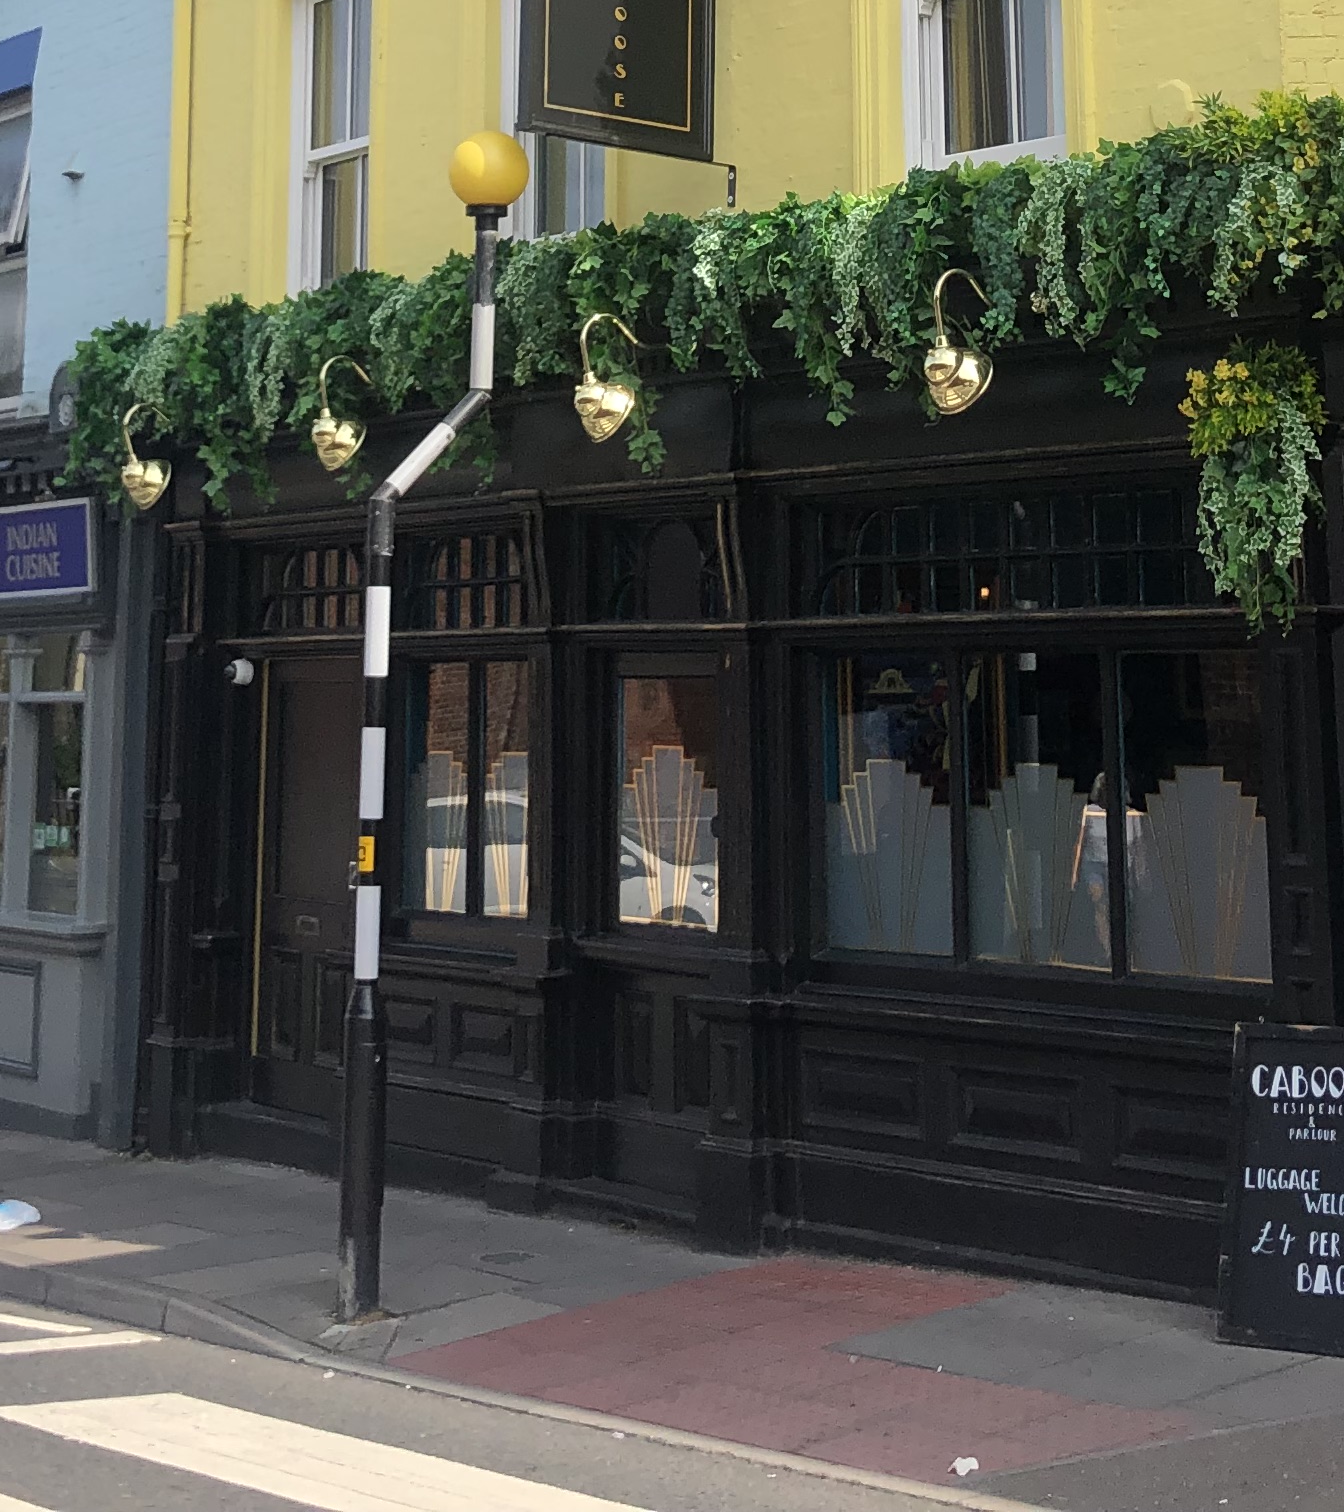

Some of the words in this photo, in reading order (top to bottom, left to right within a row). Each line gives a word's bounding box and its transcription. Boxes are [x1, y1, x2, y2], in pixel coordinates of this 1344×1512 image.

[6, 521, 58, 551] INDIAN
[5, 552, 61, 581] CUISINE
[1289, 1128, 1337, 1141] PARLOUR
[1308, 1116, 1316, 1128] &
[1244, 1166, 1320, 1191] LUGGAGE
[1251, 1221, 1295, 1256] £4
[1309, 1231, 1340, 1257] PER
